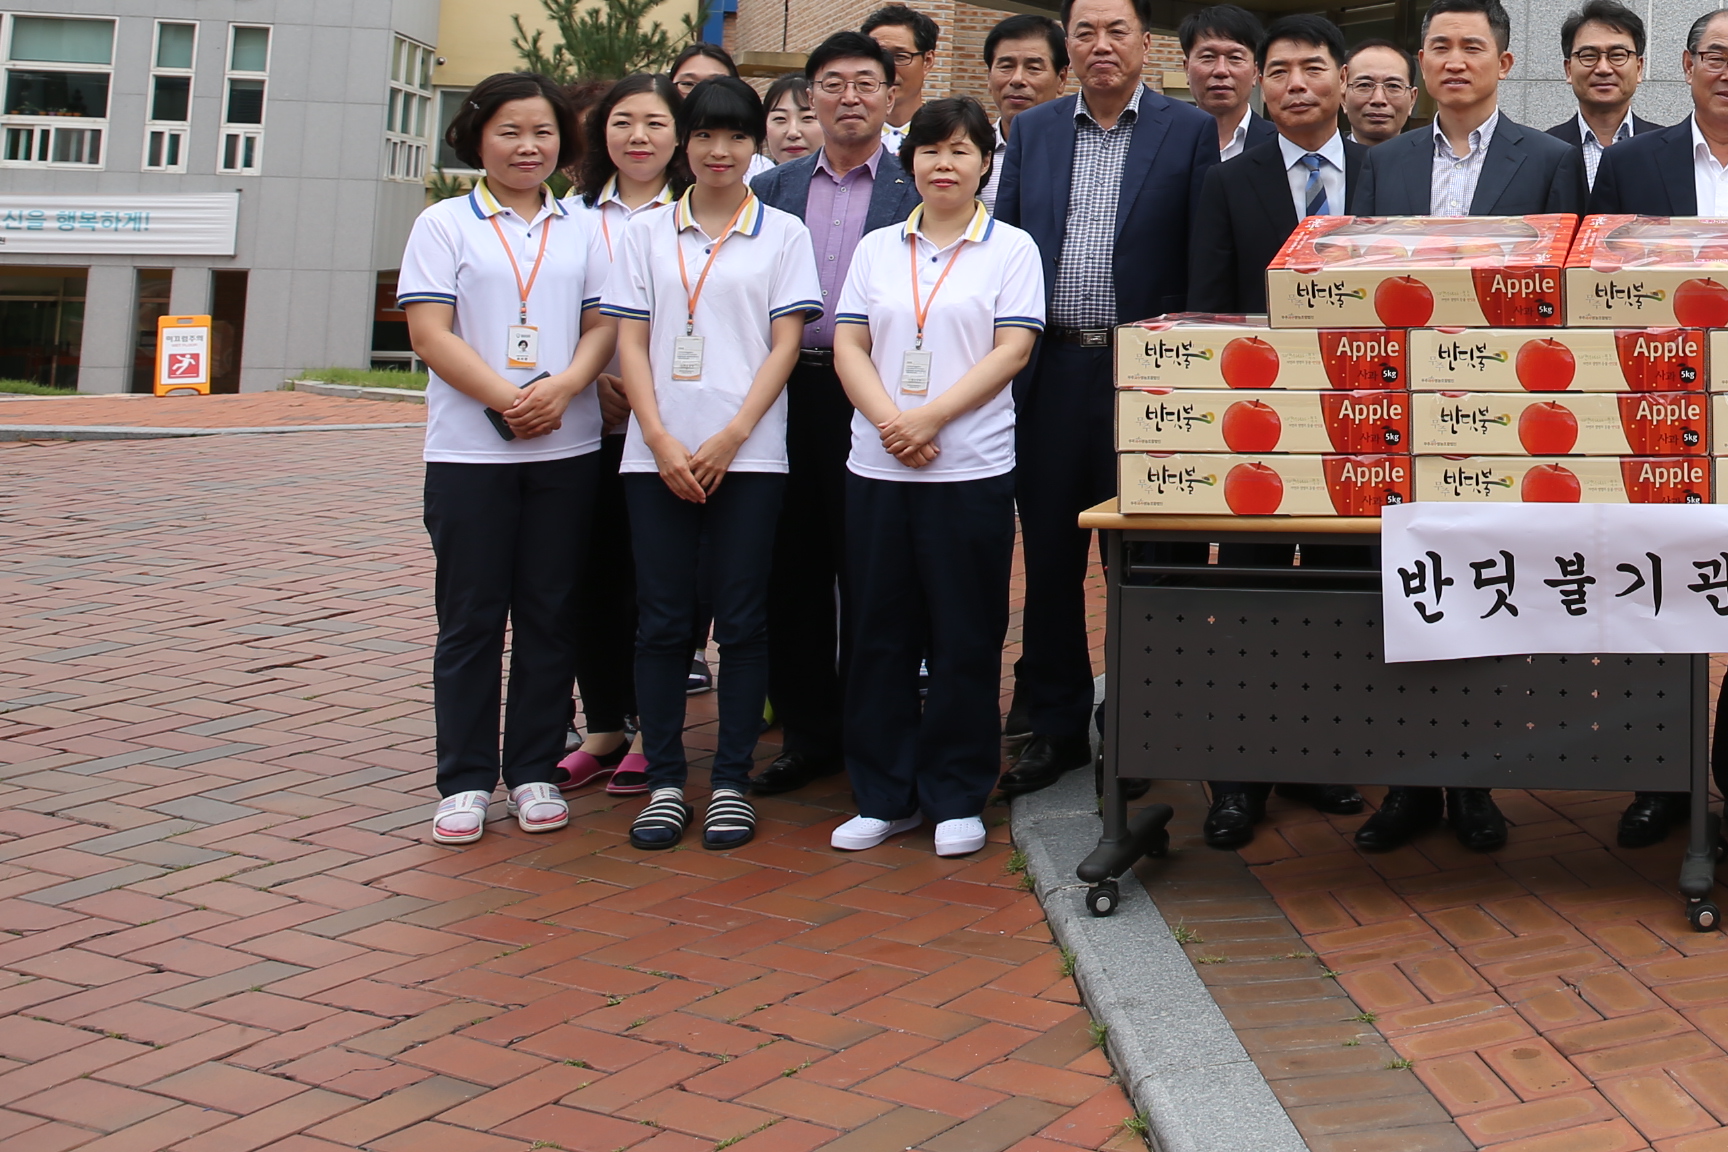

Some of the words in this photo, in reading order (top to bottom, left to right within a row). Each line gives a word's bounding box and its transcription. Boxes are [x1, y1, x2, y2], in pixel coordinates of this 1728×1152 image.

[55, 210, 151, 233] 행복하게!
[1296, 279, 1361, 309] 반딧불
[1491, 273, 1554, 299] Apple
[1594, 280, 1660, 310] 반딧불
[1513, 305, 1534, 317] 사과
[1538, 305, 1554, 315] 5kg
[1144, 339, 1209, 369] 반딧불
[1336, 336, 1399, 362] Apple
[1438, 341, 1502, 372] 반딧불
[1633, 336, 1698, 362] Apple
[1357, 369, 1378, 380] 사과
[1382, 369, 1397, 379] 5kg
[1656, 370, 1676, 381] 사과
[1680, 369, 1695, 380] 5kg
[1145, 402, 1210, 433] 반딧불
[1338, 398, 1402, 425] Apple
[1440, 404, 1505, 435] 반딧불
[1636, 399, 1700, 426] Apple
[1359, 433, 1380, 443] 사과
[1384, 432, 1400, 442] 5kg
[1657, 433, 1679, 444] 사과
[1683, 432, 1698, 443] 5kg
[1147, 464, 1211, 495] 반딧불
[1340, 461, 1404, 487] Apple
[1443, 466, 1508, 497] 반딧불
[1639, 462, 1703, 488] Apple
